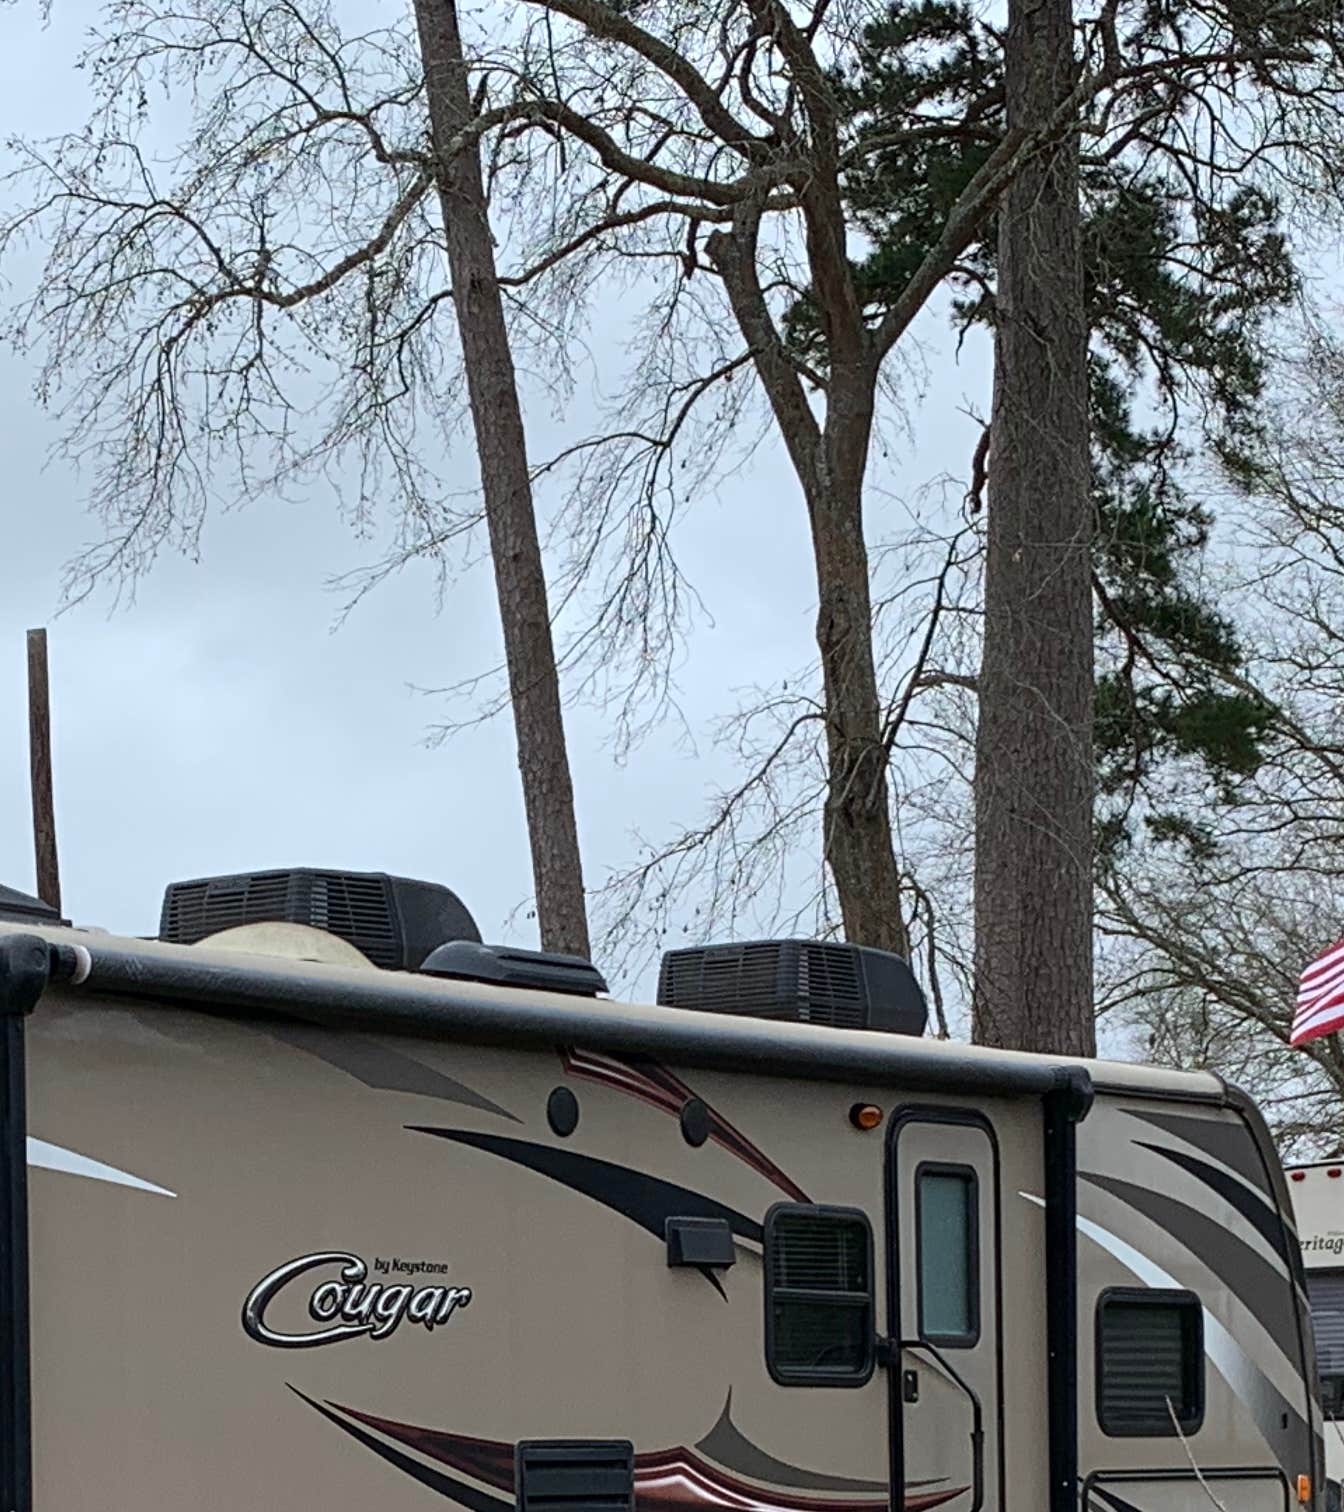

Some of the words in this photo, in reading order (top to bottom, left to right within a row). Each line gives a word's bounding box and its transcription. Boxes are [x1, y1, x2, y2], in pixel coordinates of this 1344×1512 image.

[374, 1257, 390, 1274] by
[392, 1258, 448, 1275] Keystone
[241, 1250, 472, 1349] Cougar
